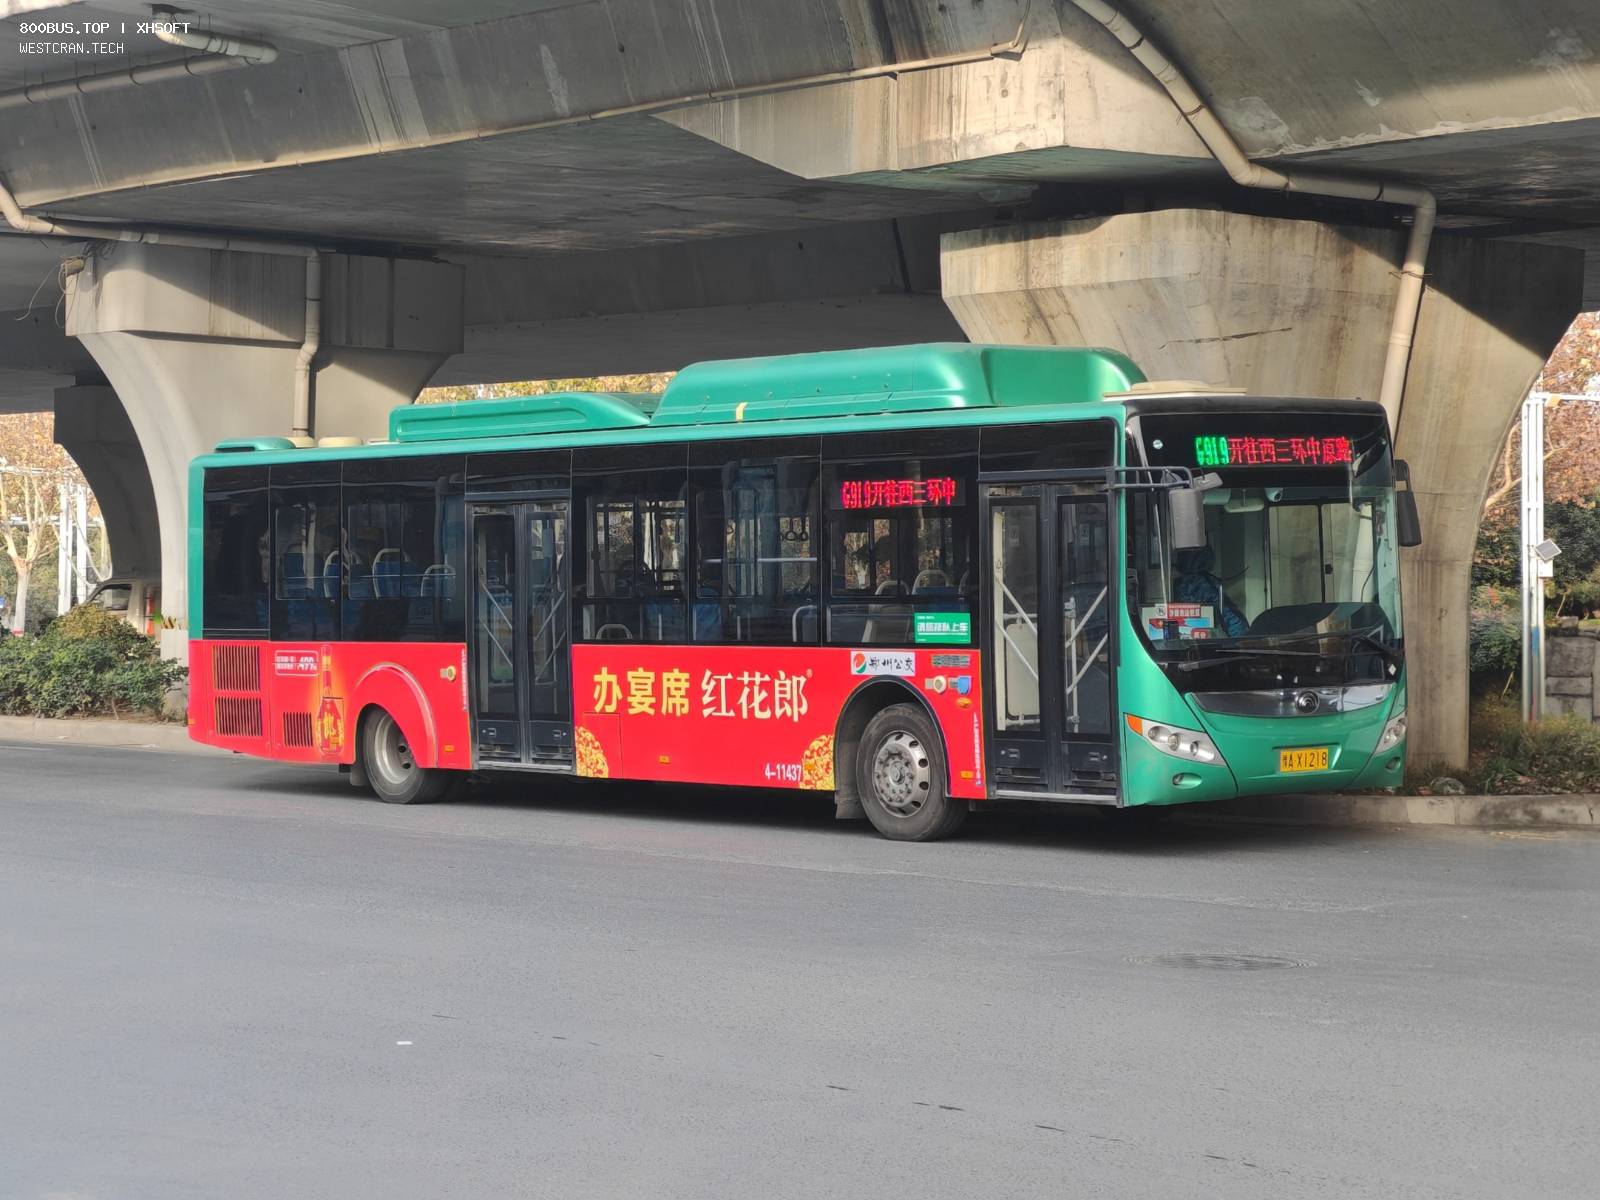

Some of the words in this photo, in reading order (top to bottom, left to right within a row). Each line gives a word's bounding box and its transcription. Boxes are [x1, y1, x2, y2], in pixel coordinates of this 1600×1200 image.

[868, 656, 914, 672] 郑州公交
[593, 666, 690, 717] 办宴席
[701, 669, 808, 722] 红花郎
[764, 763, 802, 782] 4-11437
